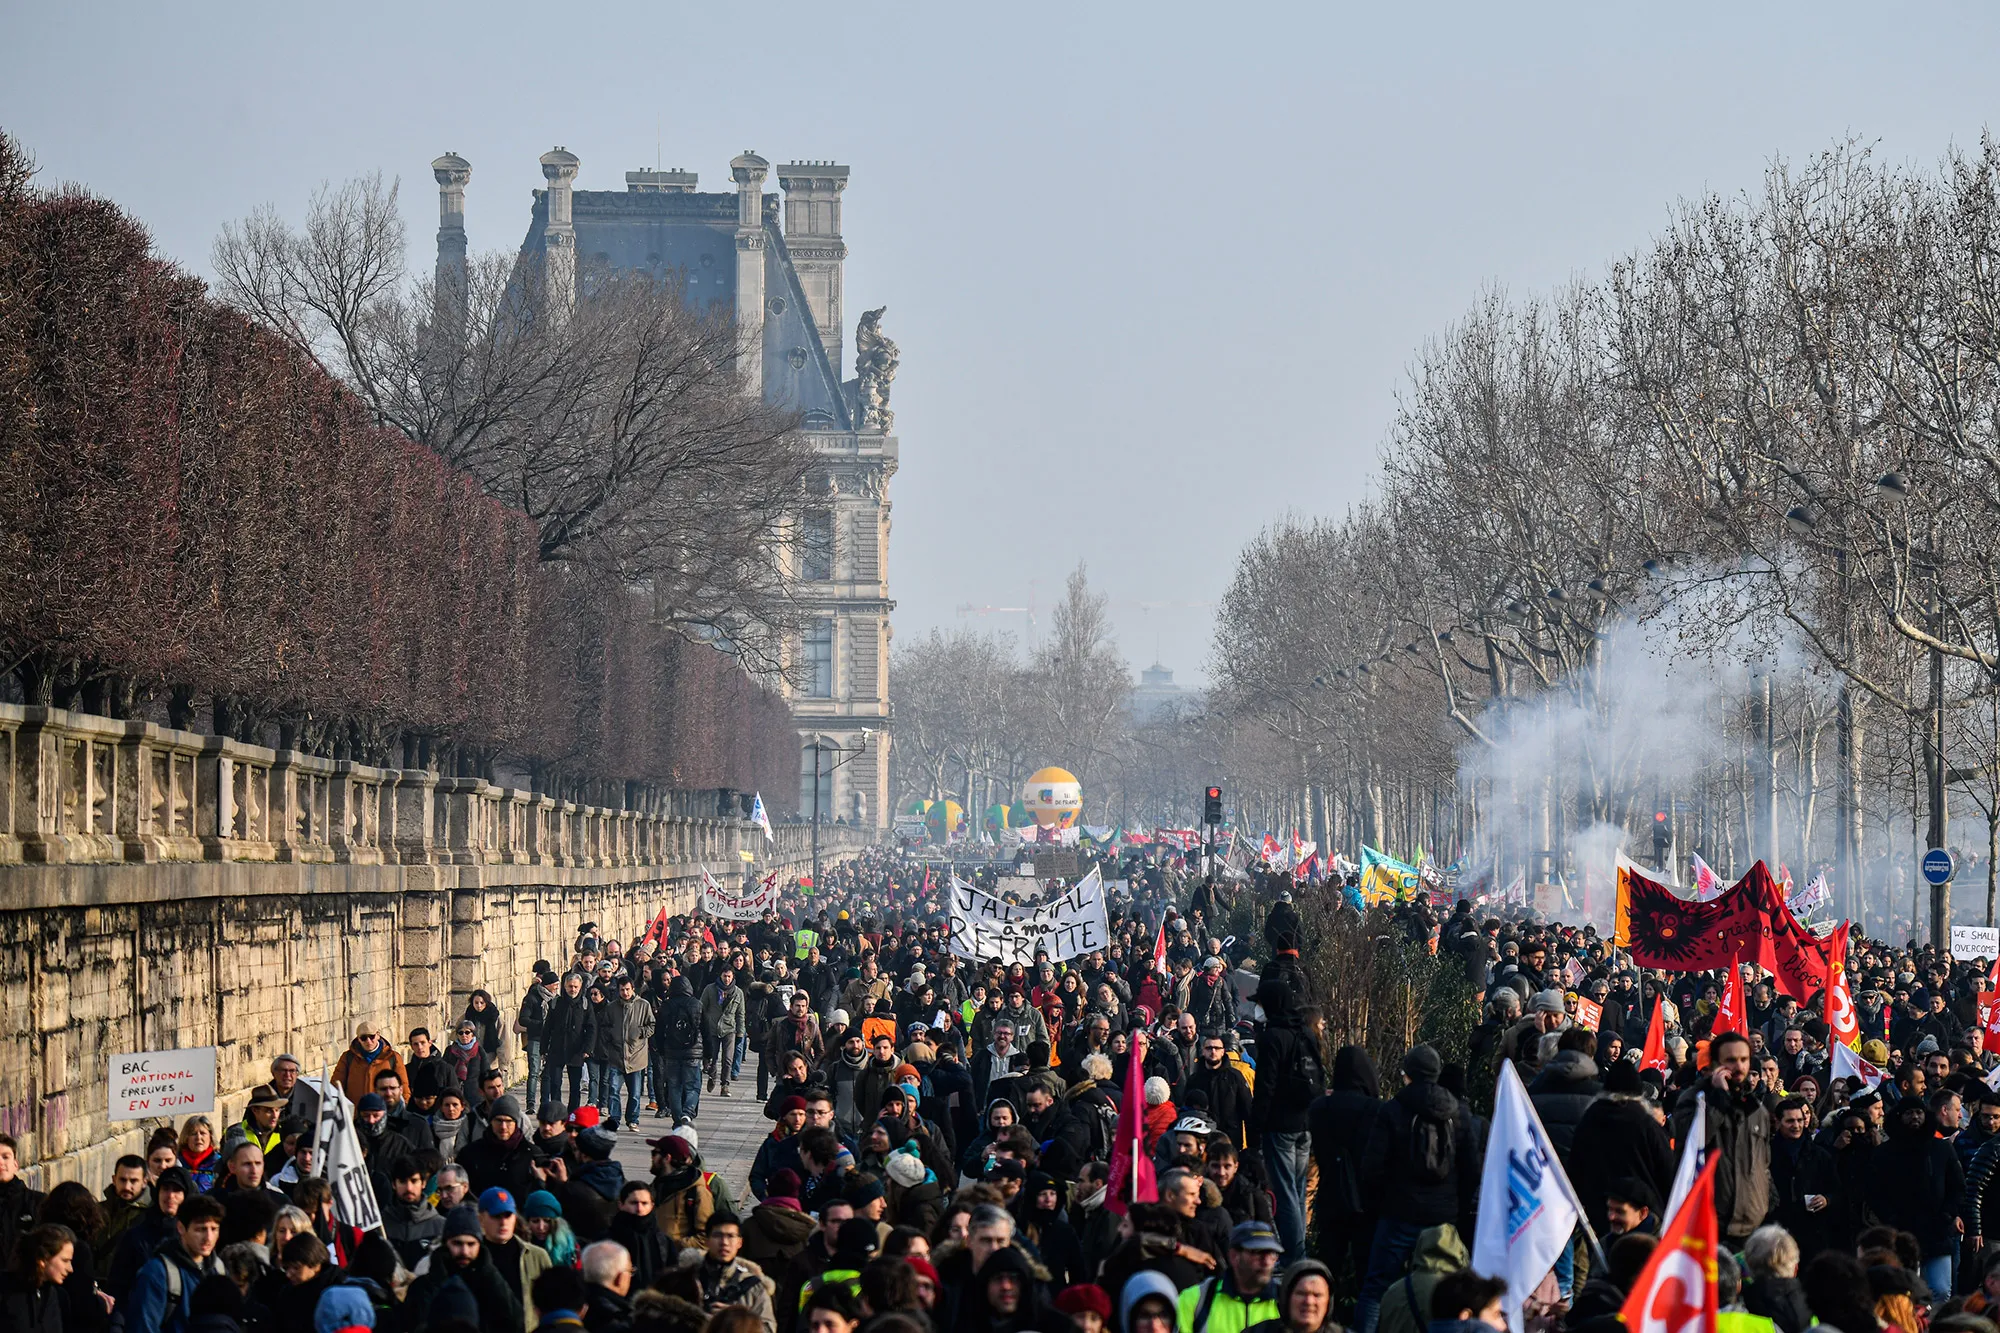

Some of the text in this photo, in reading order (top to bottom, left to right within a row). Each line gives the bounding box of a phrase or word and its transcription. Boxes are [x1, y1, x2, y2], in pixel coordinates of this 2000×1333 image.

[1033, 887, 1093, 922] MAL
[1020, 924, 1057, 938] ma
[1953, 930, 1996, 941] WE SHALL
[1954, 943, 1997, 954] OVERCOME
[122, 1060, 150, 1075] BAC
[131, 1070, 193, 1084] NATIONAL
[129, 1099, 150, 1111] EN
